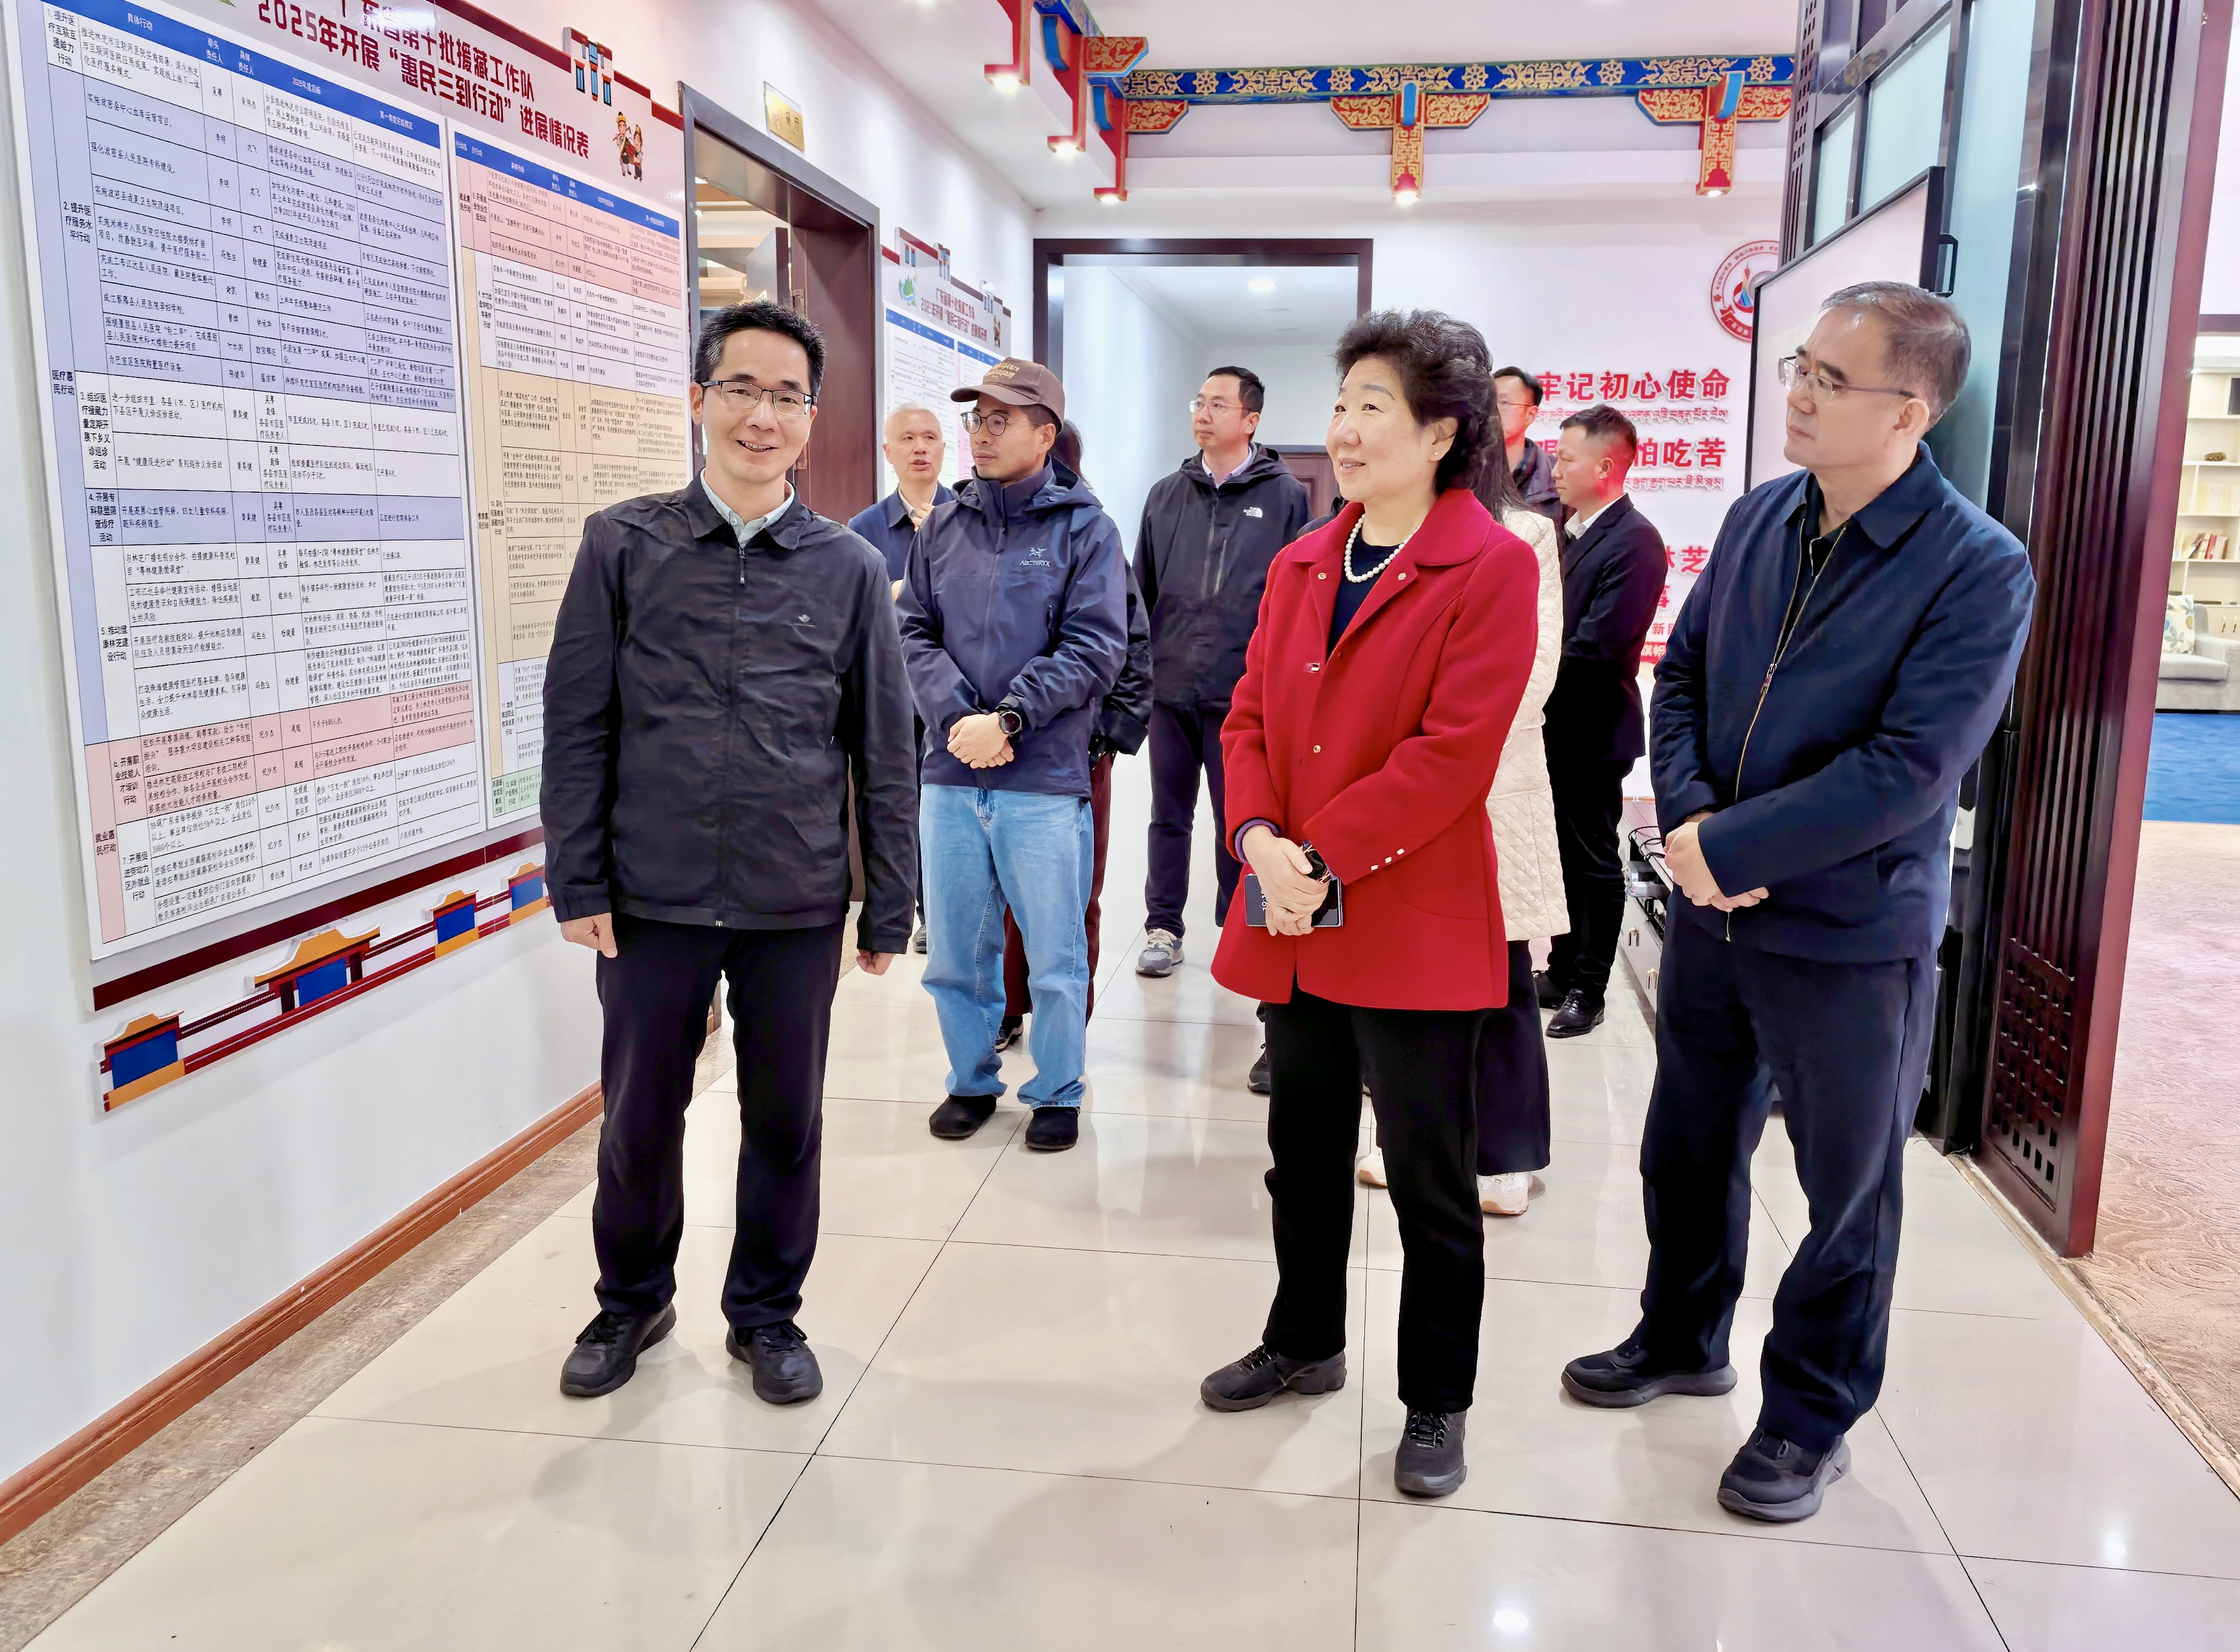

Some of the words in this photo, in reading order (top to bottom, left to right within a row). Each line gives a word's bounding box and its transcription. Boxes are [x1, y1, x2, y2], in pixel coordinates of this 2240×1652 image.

[1536, 368, 1731, 402] 牢记初心使命
[1665, 545, 1709, 574] 芝
